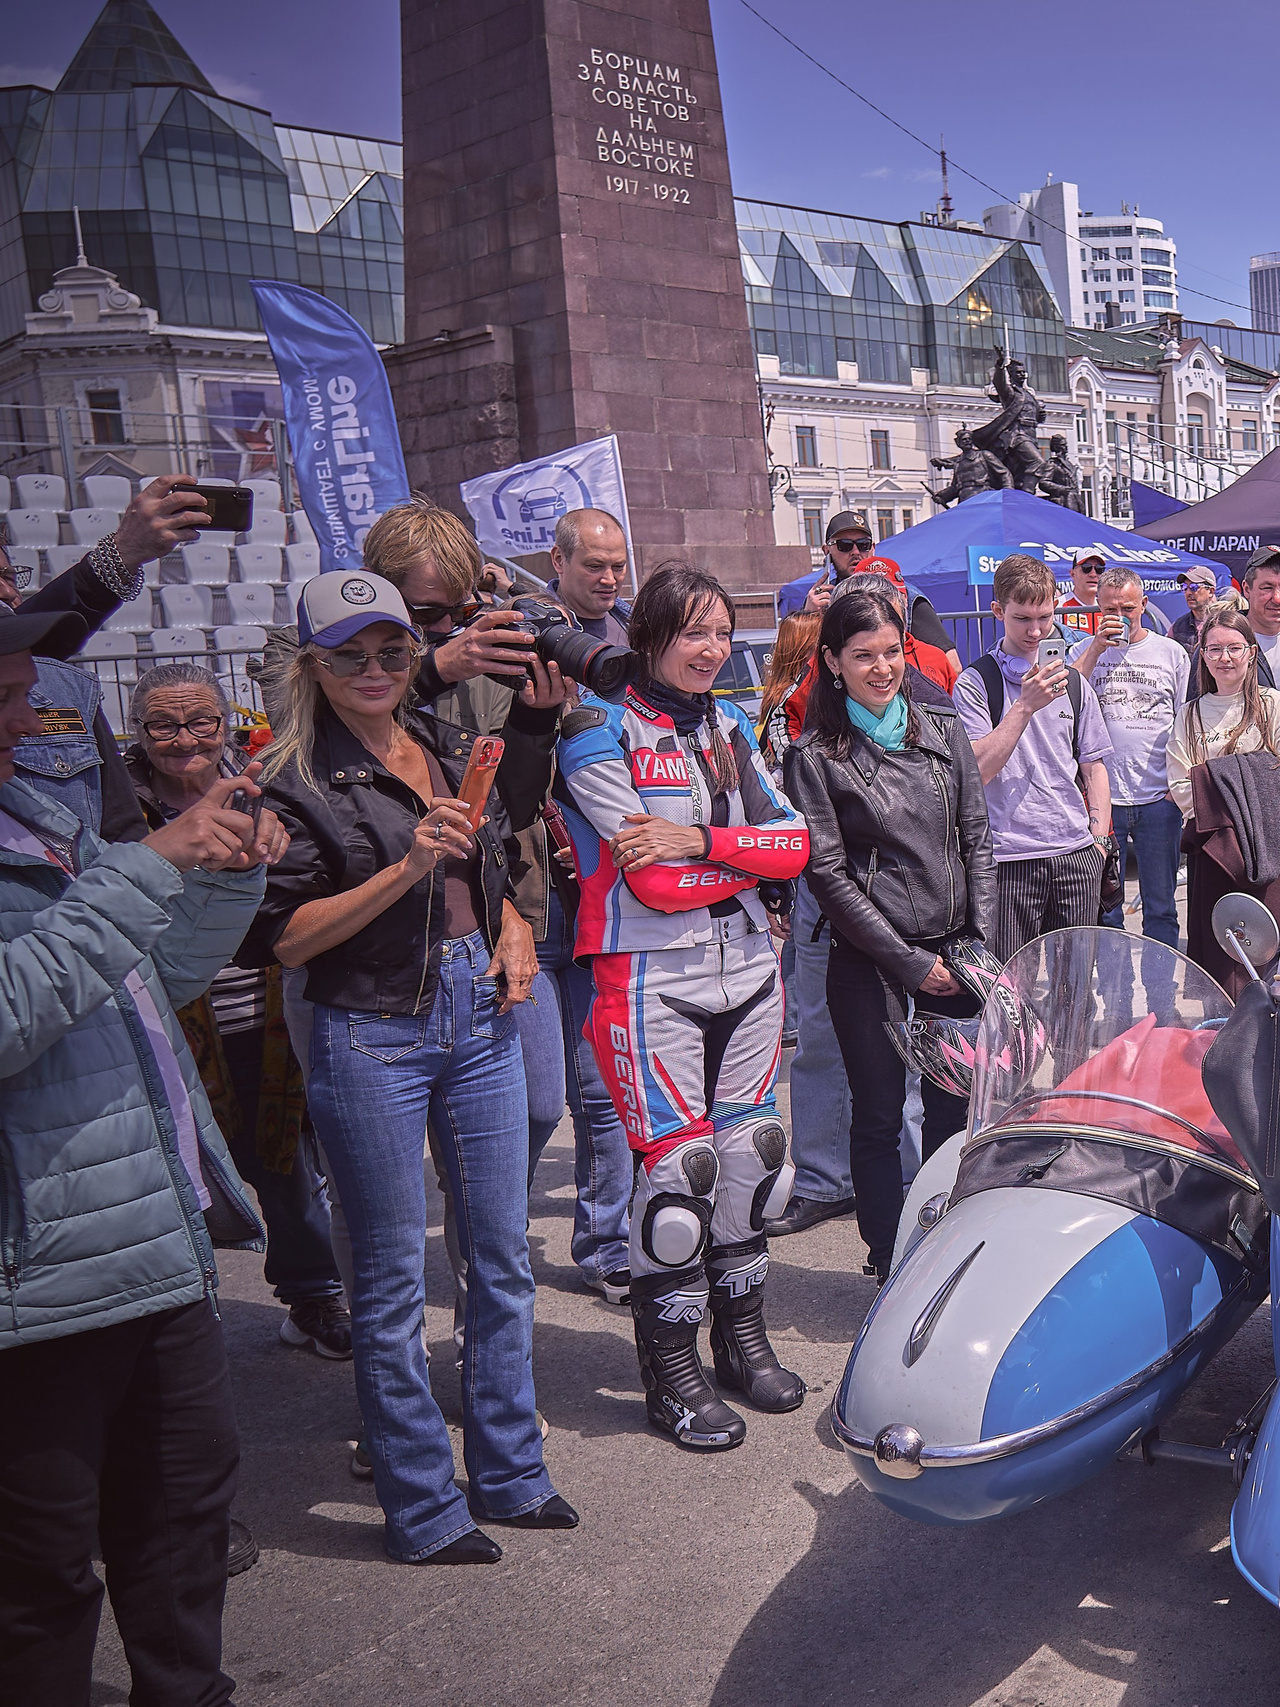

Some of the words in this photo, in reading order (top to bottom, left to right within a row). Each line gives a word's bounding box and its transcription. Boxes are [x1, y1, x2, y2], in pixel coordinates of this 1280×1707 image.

[591, 47, 681, 83] БОРЦАМ
[577, 64, 606, 85] ЗА
[618, 73, 697, 104] ВЛАСТЬ
[592, 87, 690, 121] СОВЕТОВ
[630, 112, 657, 133] НА
[596, 126, 694, 160] ДАЛЬНЕМ
[598, 145, 695, 178] ВОСТОКЕ
[1160, 537, 1187, 551] ADE
[1190, 537, 1204, 552] IN
[1208, 535, 1260, 552] JAPAN
[978, 555, 1001, 573] Sta
[627, 696, 659, 719] BERG
[44, 723, 70, 731] RIYSK
[685, 756, 702, 824] BERG
[737, 836, 803, 850] BERG
[610, 1022, 644, 1139] BERG
